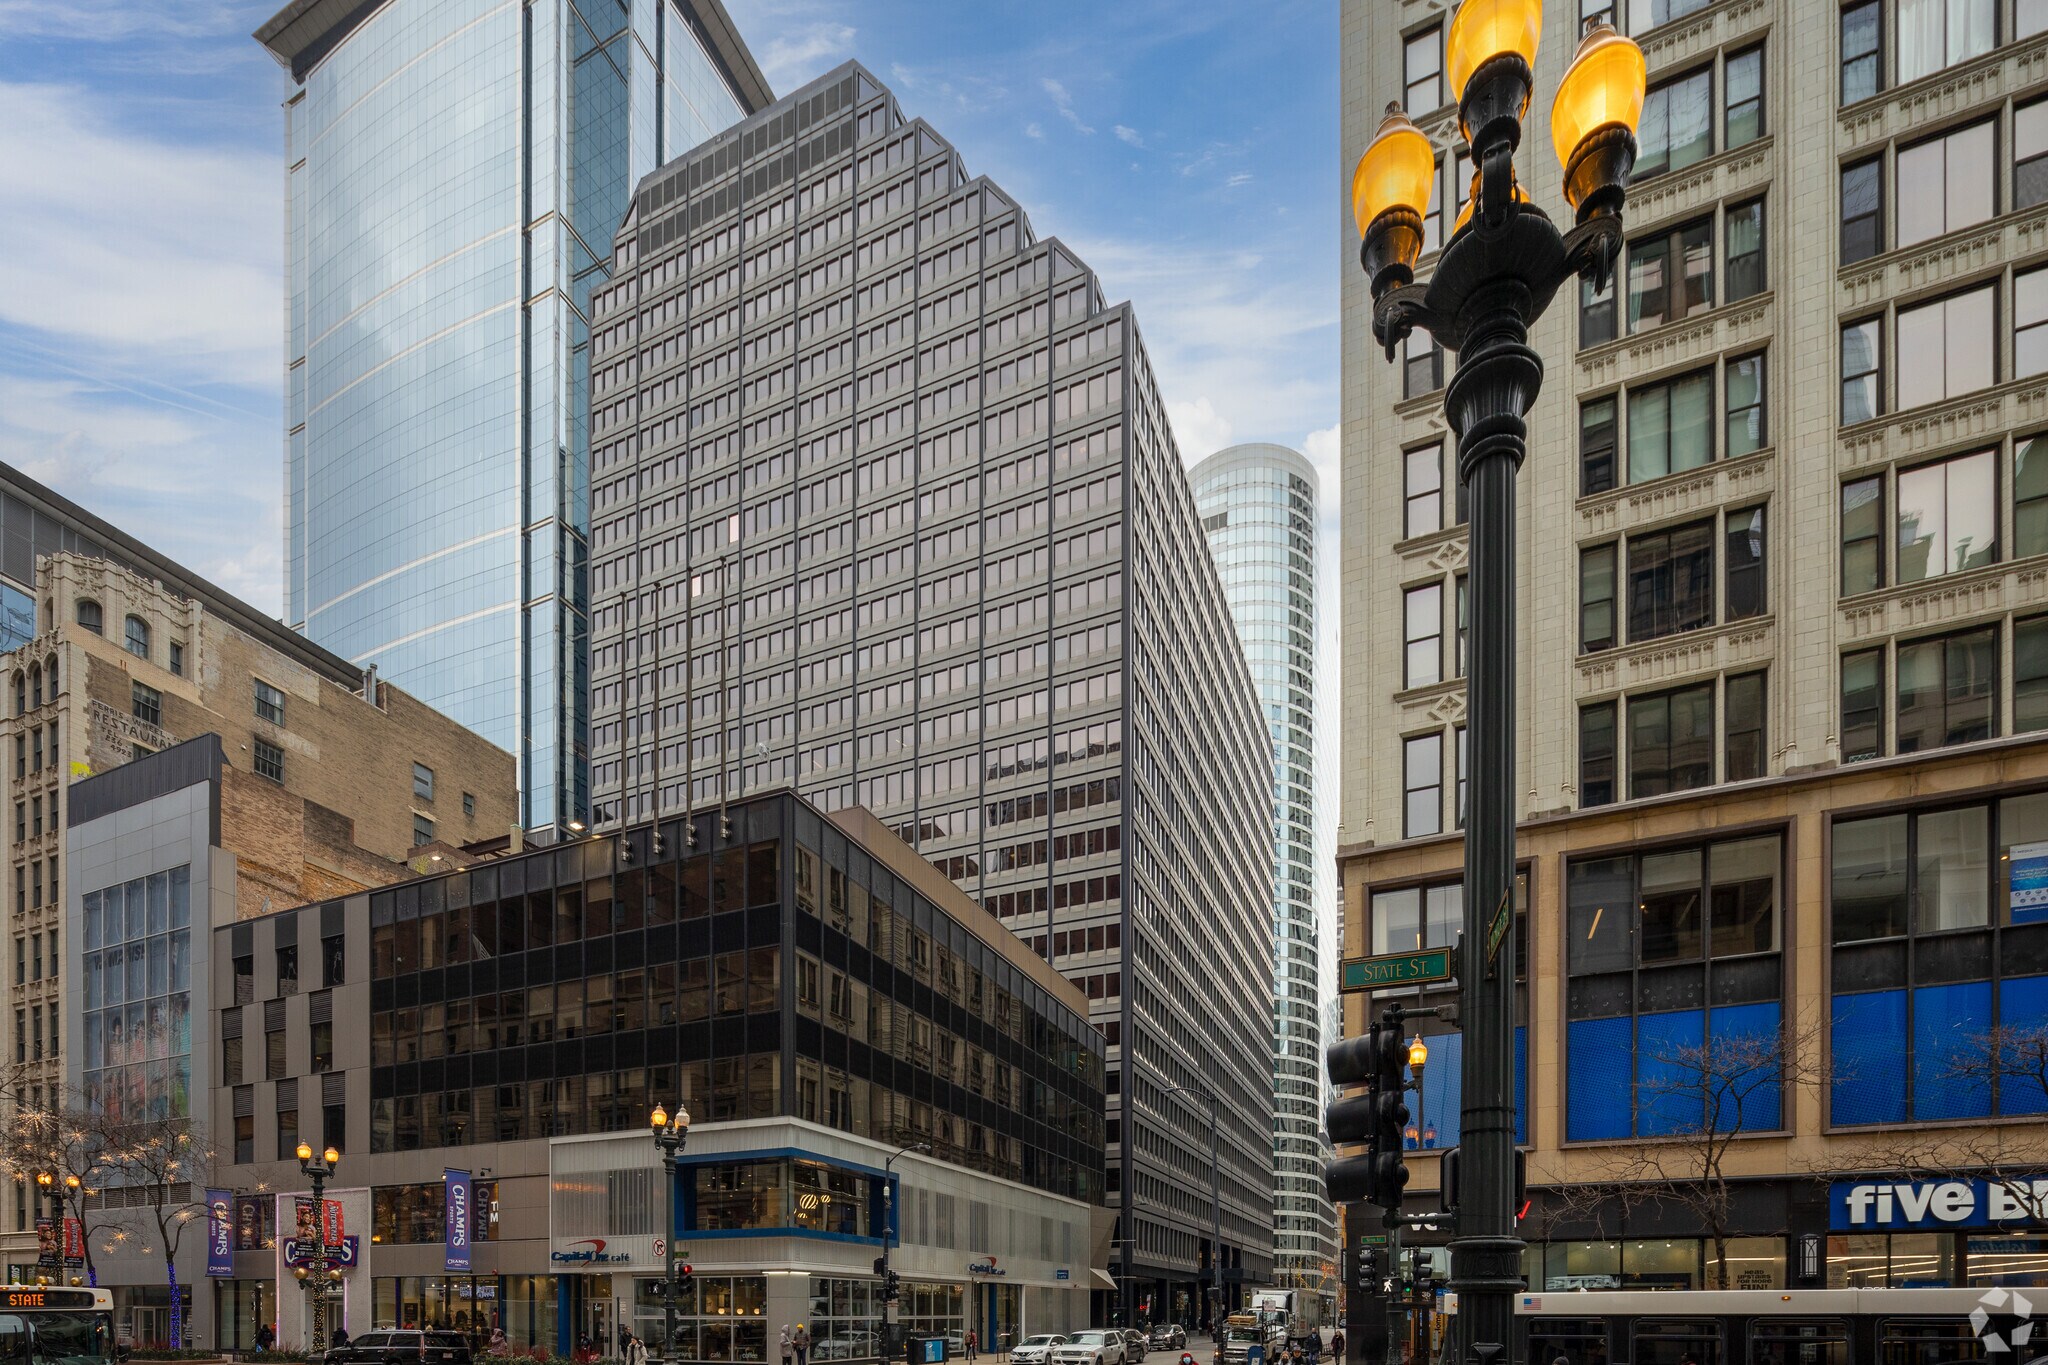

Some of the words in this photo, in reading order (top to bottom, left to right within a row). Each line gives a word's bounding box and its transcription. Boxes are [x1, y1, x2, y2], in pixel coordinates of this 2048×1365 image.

[133, 716, 166, 739] WHEEL
[1364, 963, 1403, 981] STATE
[1410, 958, 1430, 977] ST.
[1845, 1182, 1975, 1224] five
[452, 1184, 465, 1247] CHAMPS
[213, 1201, 228, 1256] CAMPS
[308, 1261, 329, 1269] SPTS
[447, 1258, 469, 1266] CHAMPS
[611, 1252, 630, 1262] café
[9, 1293, 45, 1306] STATE
